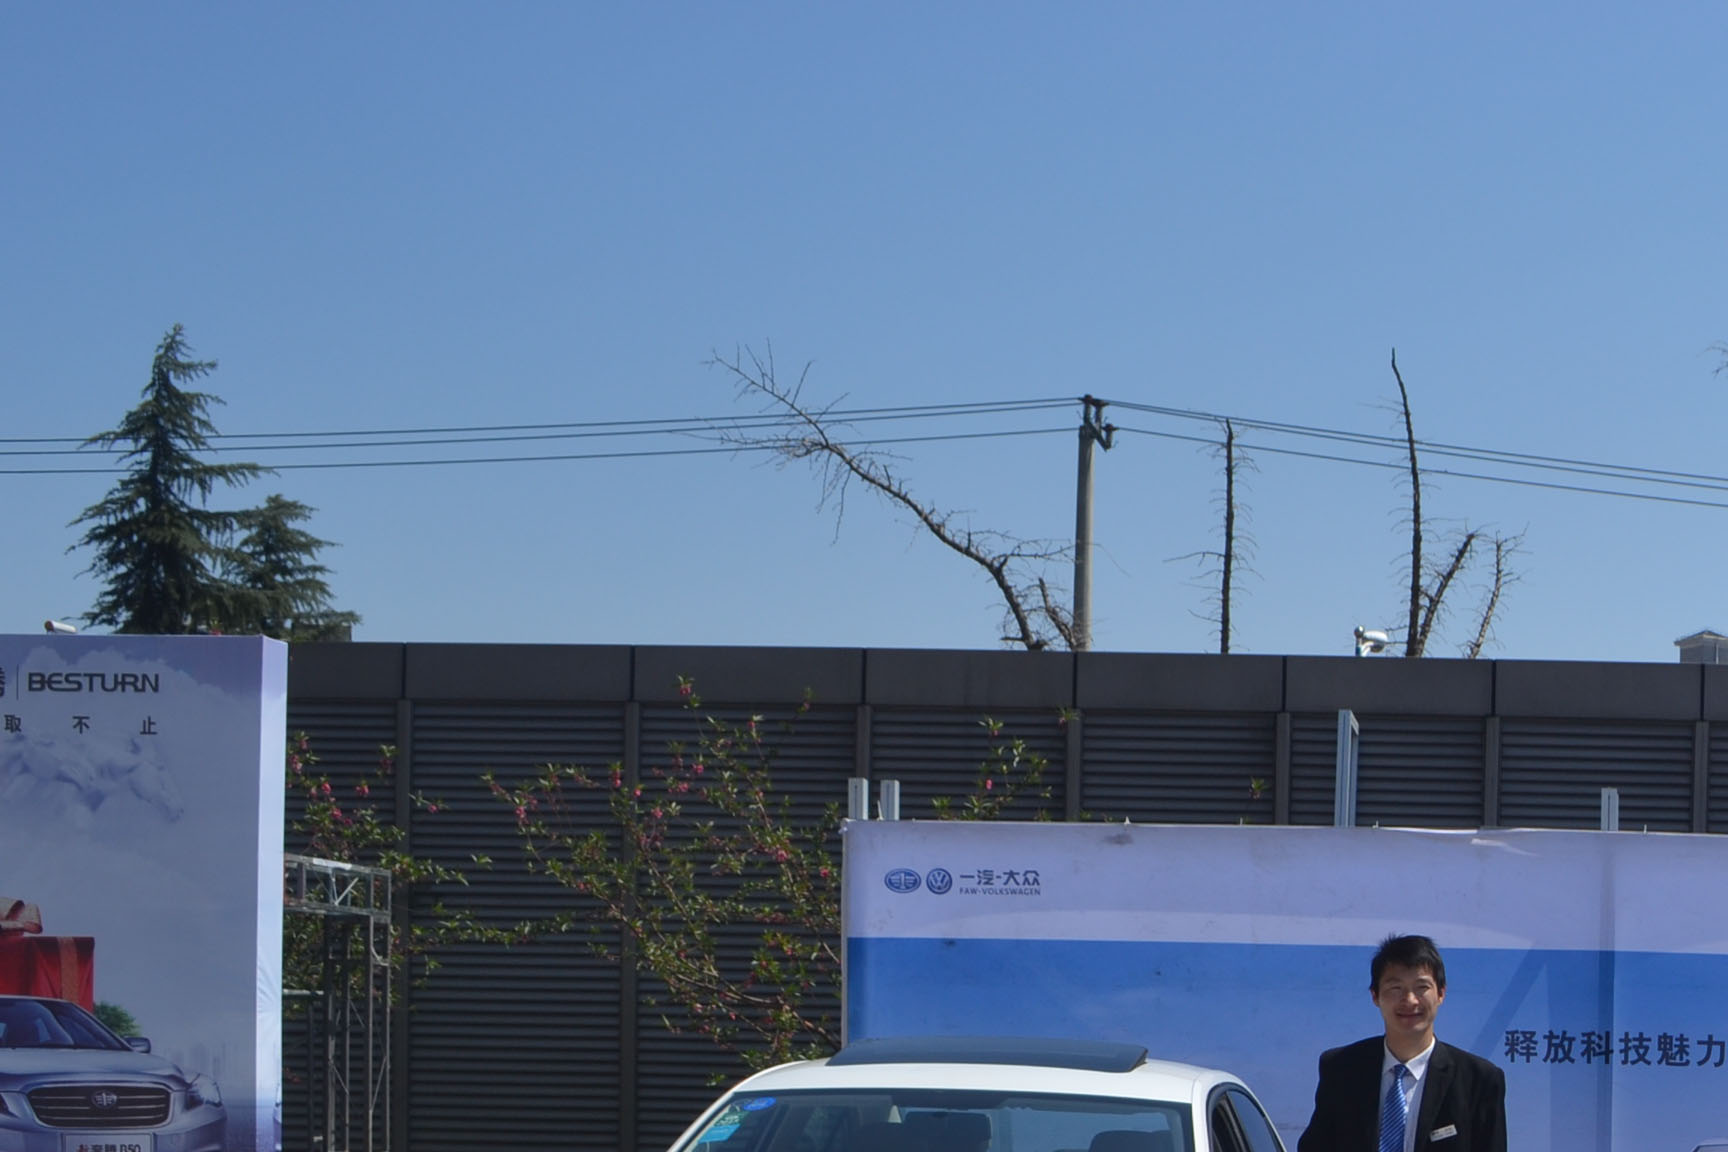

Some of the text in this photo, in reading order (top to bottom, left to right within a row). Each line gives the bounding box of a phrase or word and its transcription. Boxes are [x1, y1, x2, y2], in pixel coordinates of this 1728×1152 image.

[28, 672, 159, 693] BESTURN
[1504, 1029, 1726, 1068] 释放科技魅力
